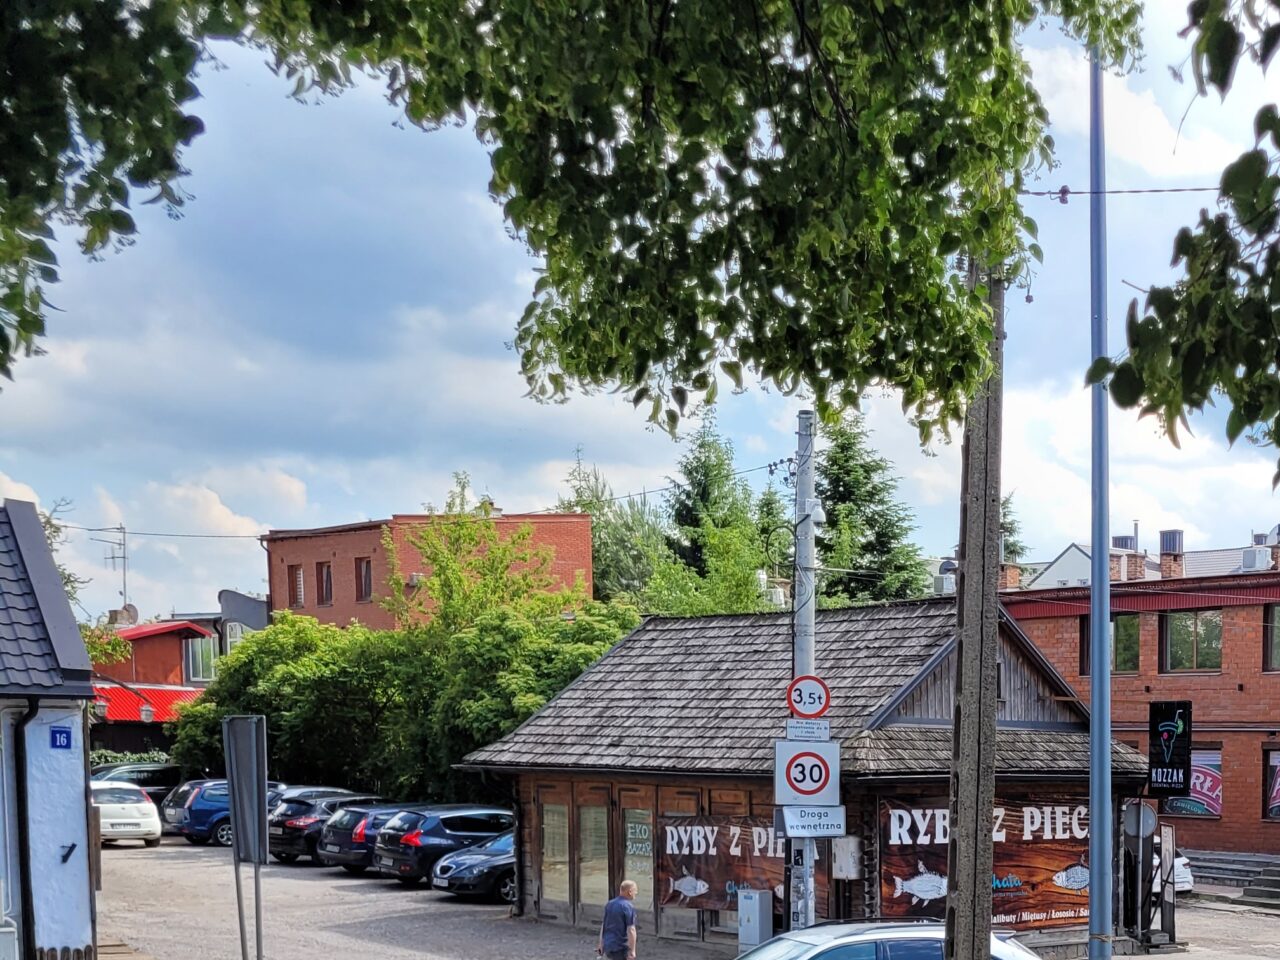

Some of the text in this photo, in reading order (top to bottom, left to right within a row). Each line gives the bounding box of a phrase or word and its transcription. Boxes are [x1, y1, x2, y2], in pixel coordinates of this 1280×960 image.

[793, 688, 823, 706] 3,5t
[55, 733, 67, 746] 16
[793, 763, 823, 783] 30
[1152, 768, 1184, 782] KOZZAK
[800, 810, 829, 820] Droga
[627, 823, 649, 839] EKO
[789, 823, 842, 833] wewnętrzna
[888, 805, 1089, 845] RYB Z PIEC
[665, 826, 718, 856] RYBY
[730, 826, 742, 857] Z
[992, 872, 1023, 890] hata
[1021, 911, 1046, 922] Miętusy
